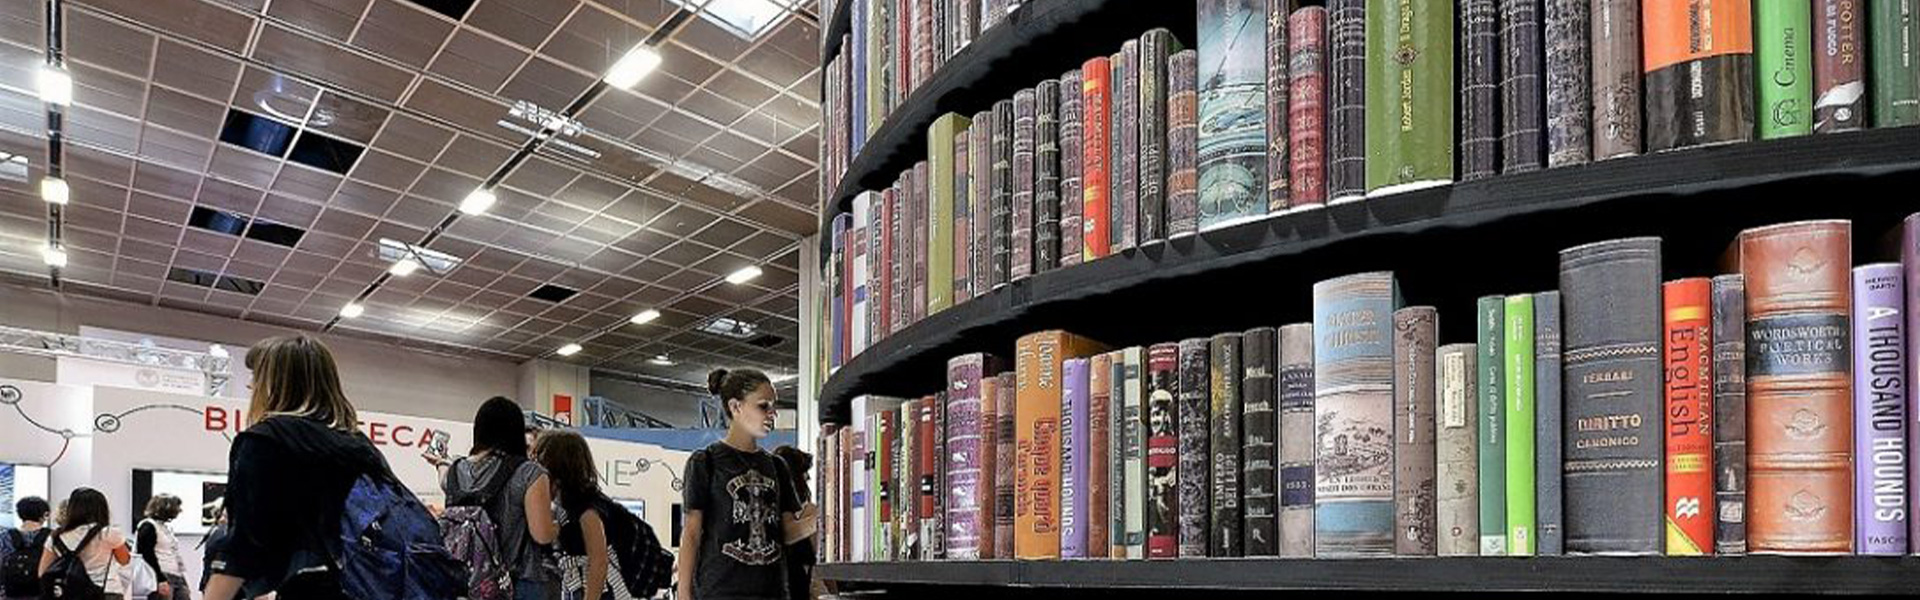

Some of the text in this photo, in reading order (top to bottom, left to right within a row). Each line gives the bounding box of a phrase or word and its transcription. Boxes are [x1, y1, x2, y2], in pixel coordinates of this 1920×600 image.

[1773, 27, 1797, 88] Cinema
[1664, 327, 1697, 438] English
[1698, 325, 1709, 436] MACMILLAN
[1776, 352, 1834, 366] WORKS
[206, 406, 437, 447] BIECA
[1576, 435, 1640, 449] CANONICO
[1577, 413, 1643, 432] DIRITTO
[1867, 306, 1905, 523] A THOUSAND HOUNDS
[1061, 475, 1075, 537] HOUNDS
[1225, 453, 1237, 509] DEI LUPI
